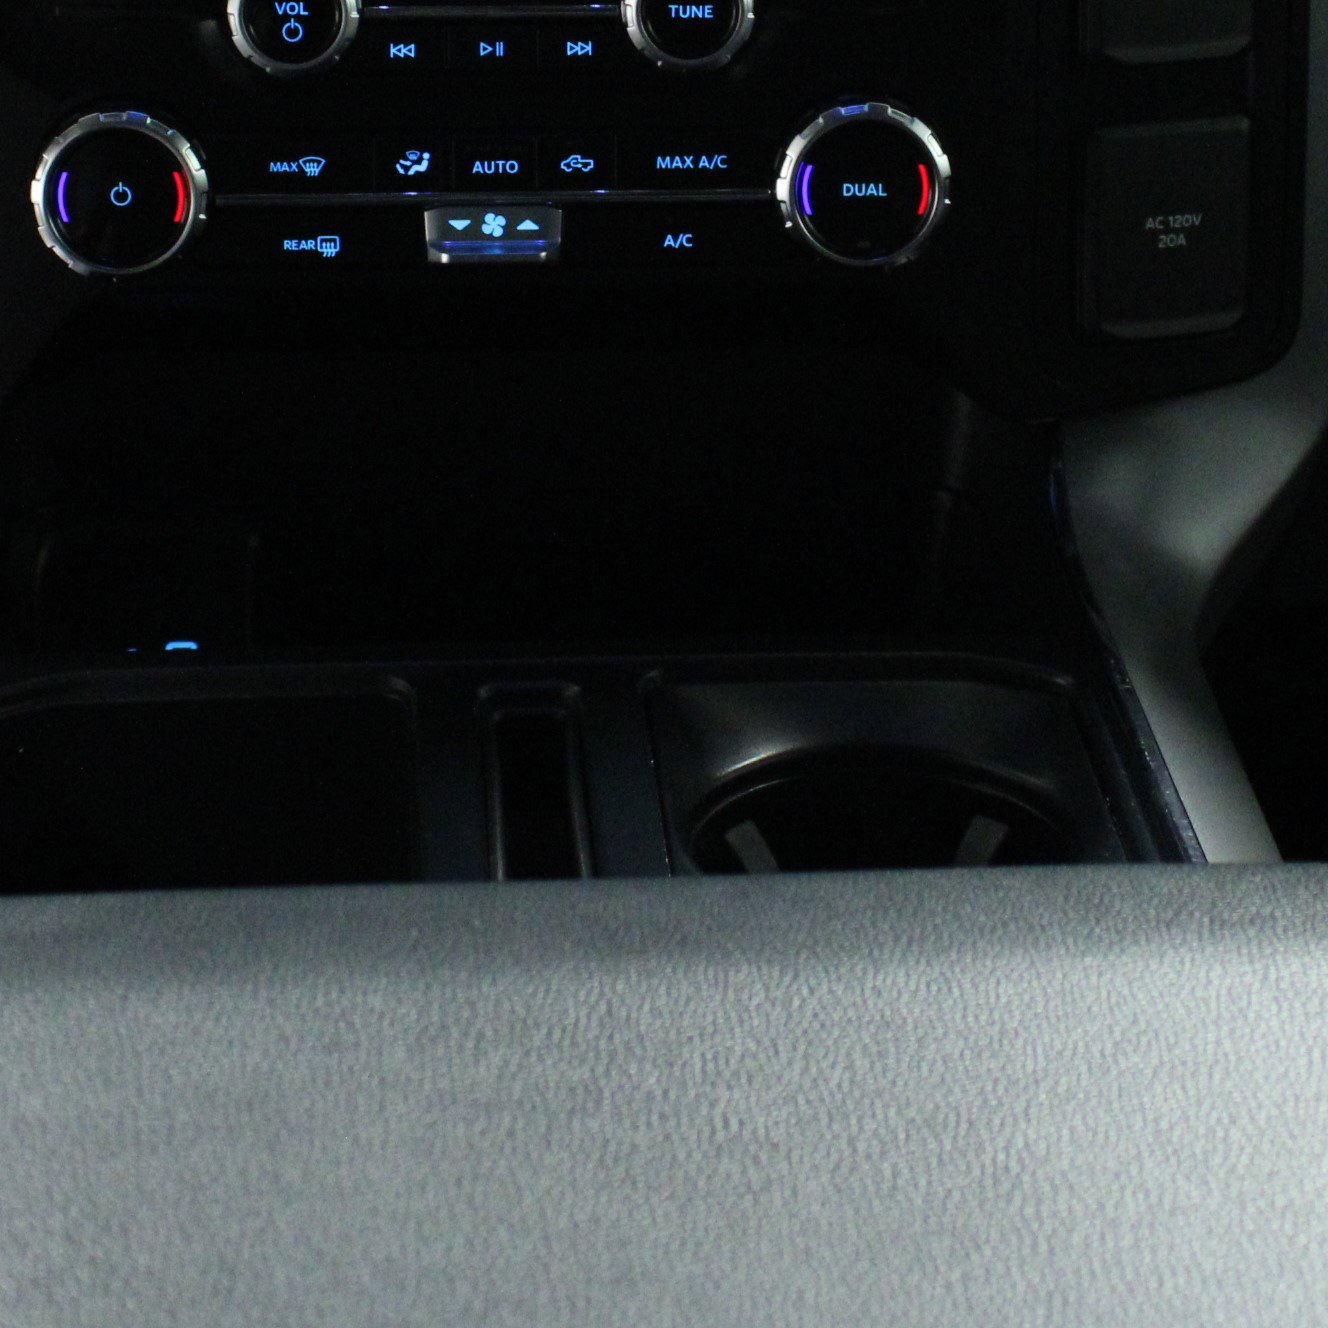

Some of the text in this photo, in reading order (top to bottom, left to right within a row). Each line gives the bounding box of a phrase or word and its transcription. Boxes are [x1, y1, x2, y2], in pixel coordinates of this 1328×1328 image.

[275, 2, 308, 15] VOL
[669, 5, 713, 18] TUNE
[270, 162, 298, 171] MAX
[473, 161, 518, 173] AUTO
[657, 155, 726, 169] MAX A/C
[843, 183, 886, 196] DUAL
[1145, 217, 1164, 230] AC
[284, 240, 315, 250] REAR
[664, 234, 692, 248] A/C
